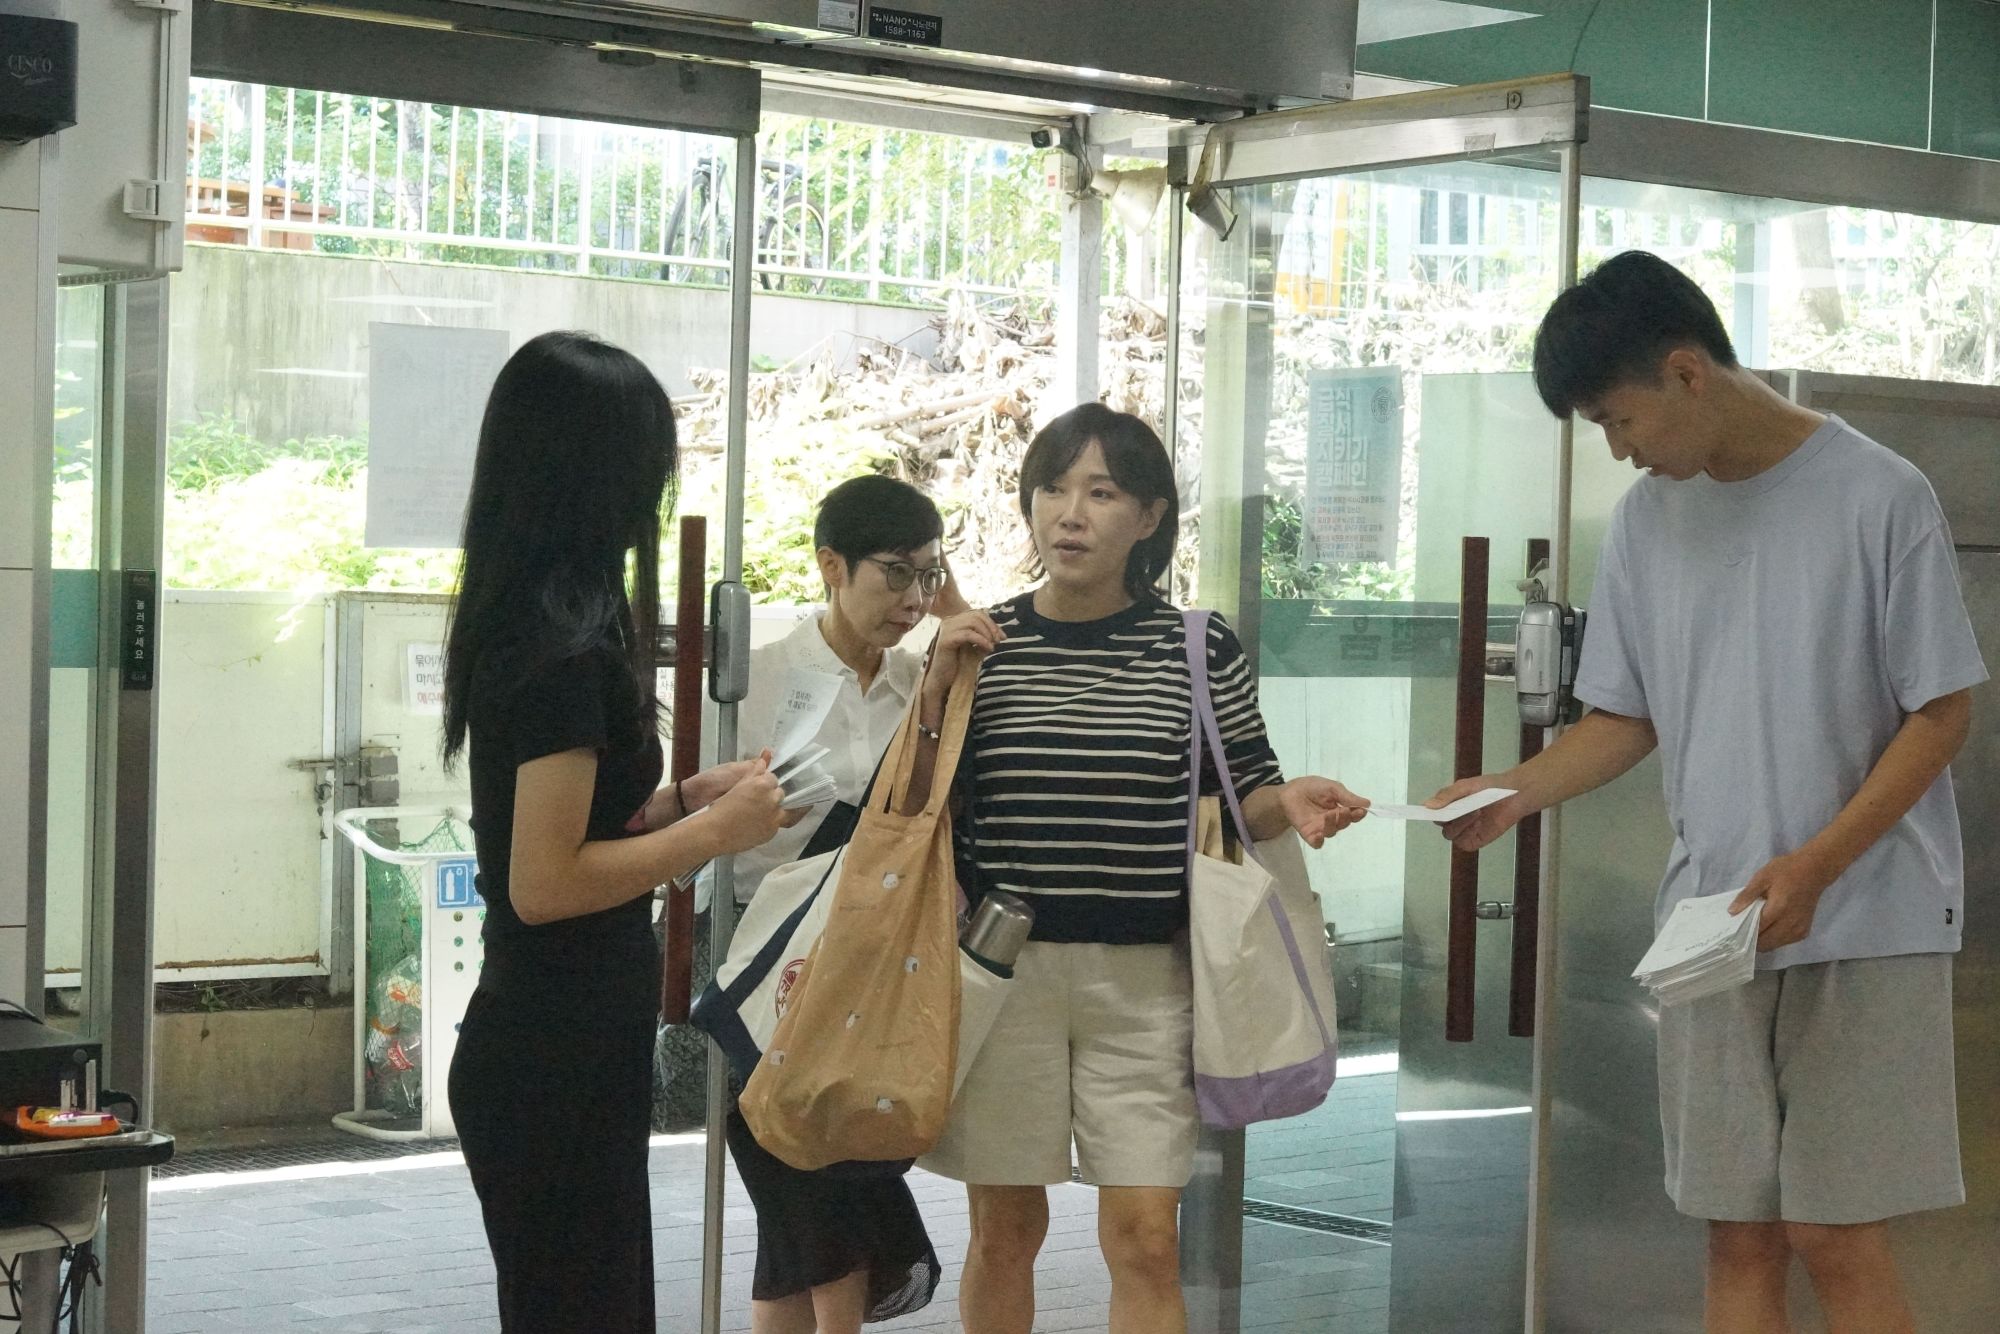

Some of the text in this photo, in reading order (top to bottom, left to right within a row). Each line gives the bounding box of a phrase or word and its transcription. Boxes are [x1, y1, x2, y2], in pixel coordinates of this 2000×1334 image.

[883, 15, 908, 27] NANO
[884, 25, 926, 40] 1588-1163
[1316, 436, 1368, 462] 지키기
[1316, 461, 1368, 487] 캠페인
